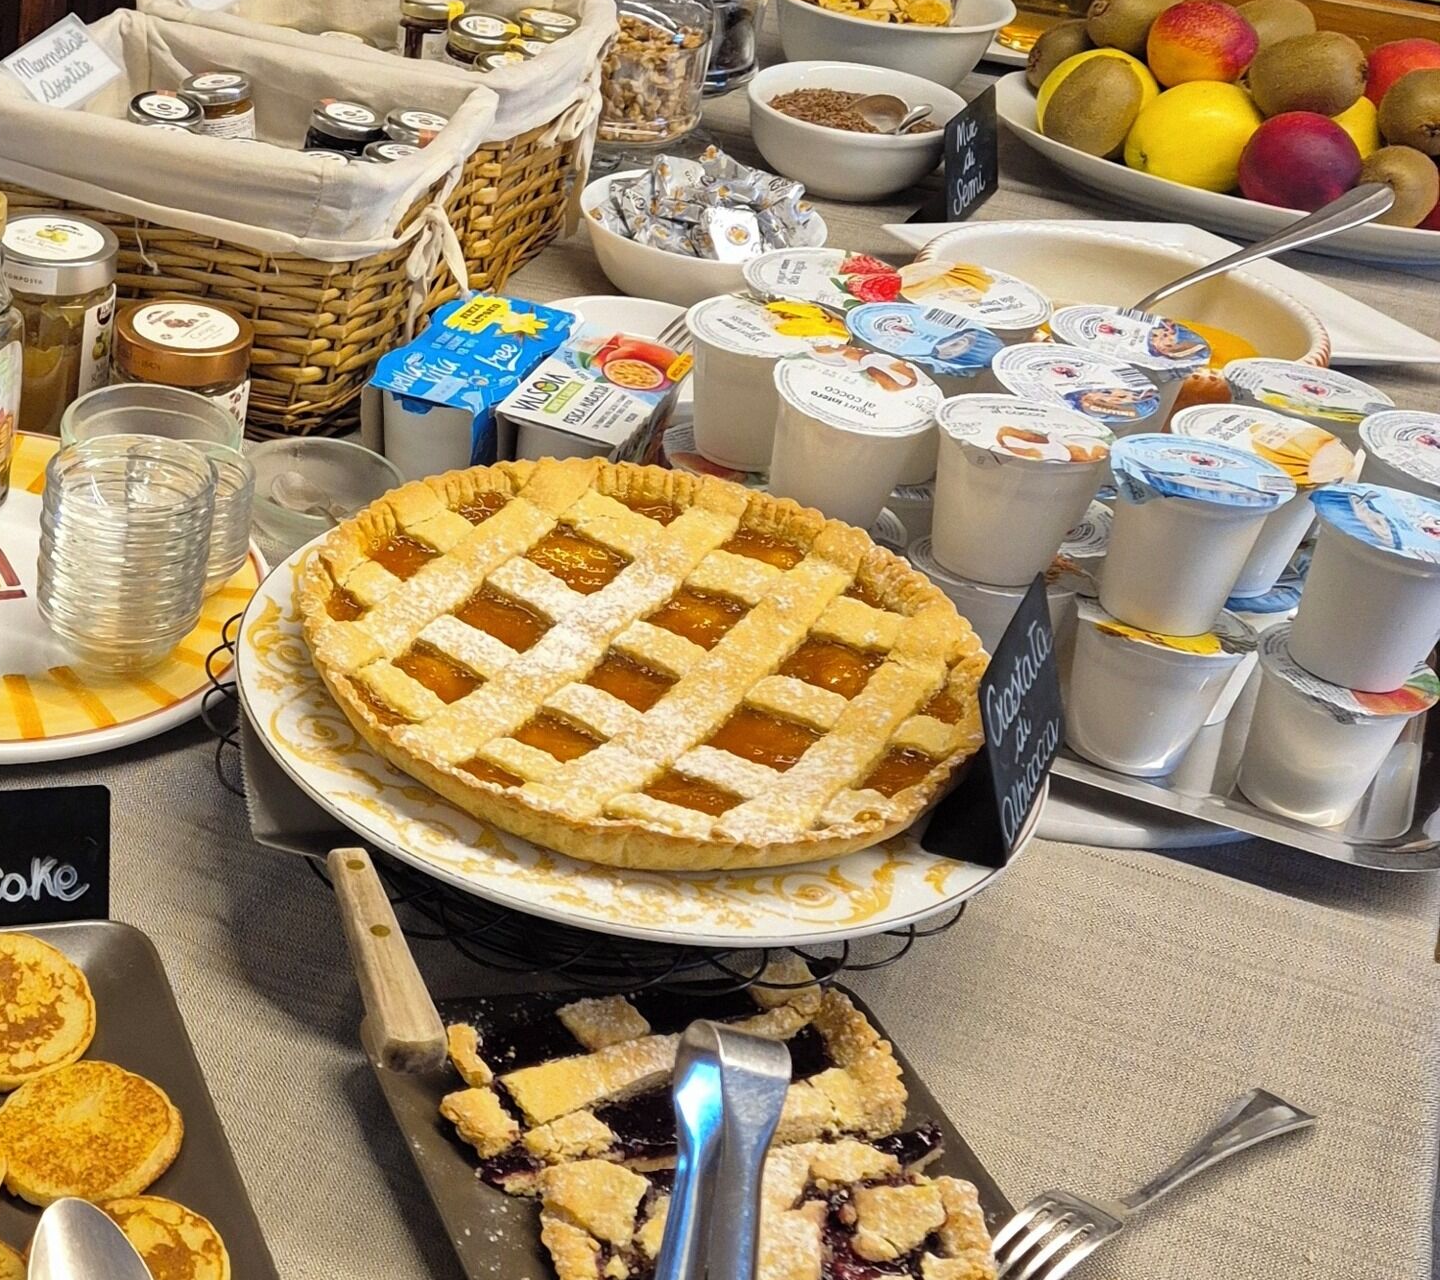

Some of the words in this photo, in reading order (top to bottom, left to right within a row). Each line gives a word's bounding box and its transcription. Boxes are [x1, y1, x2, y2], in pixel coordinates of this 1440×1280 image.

[810, 389, 844, 408] intero
[824, 385, 862, 404] cocco
[843, 400, 879, 420] yogurt
